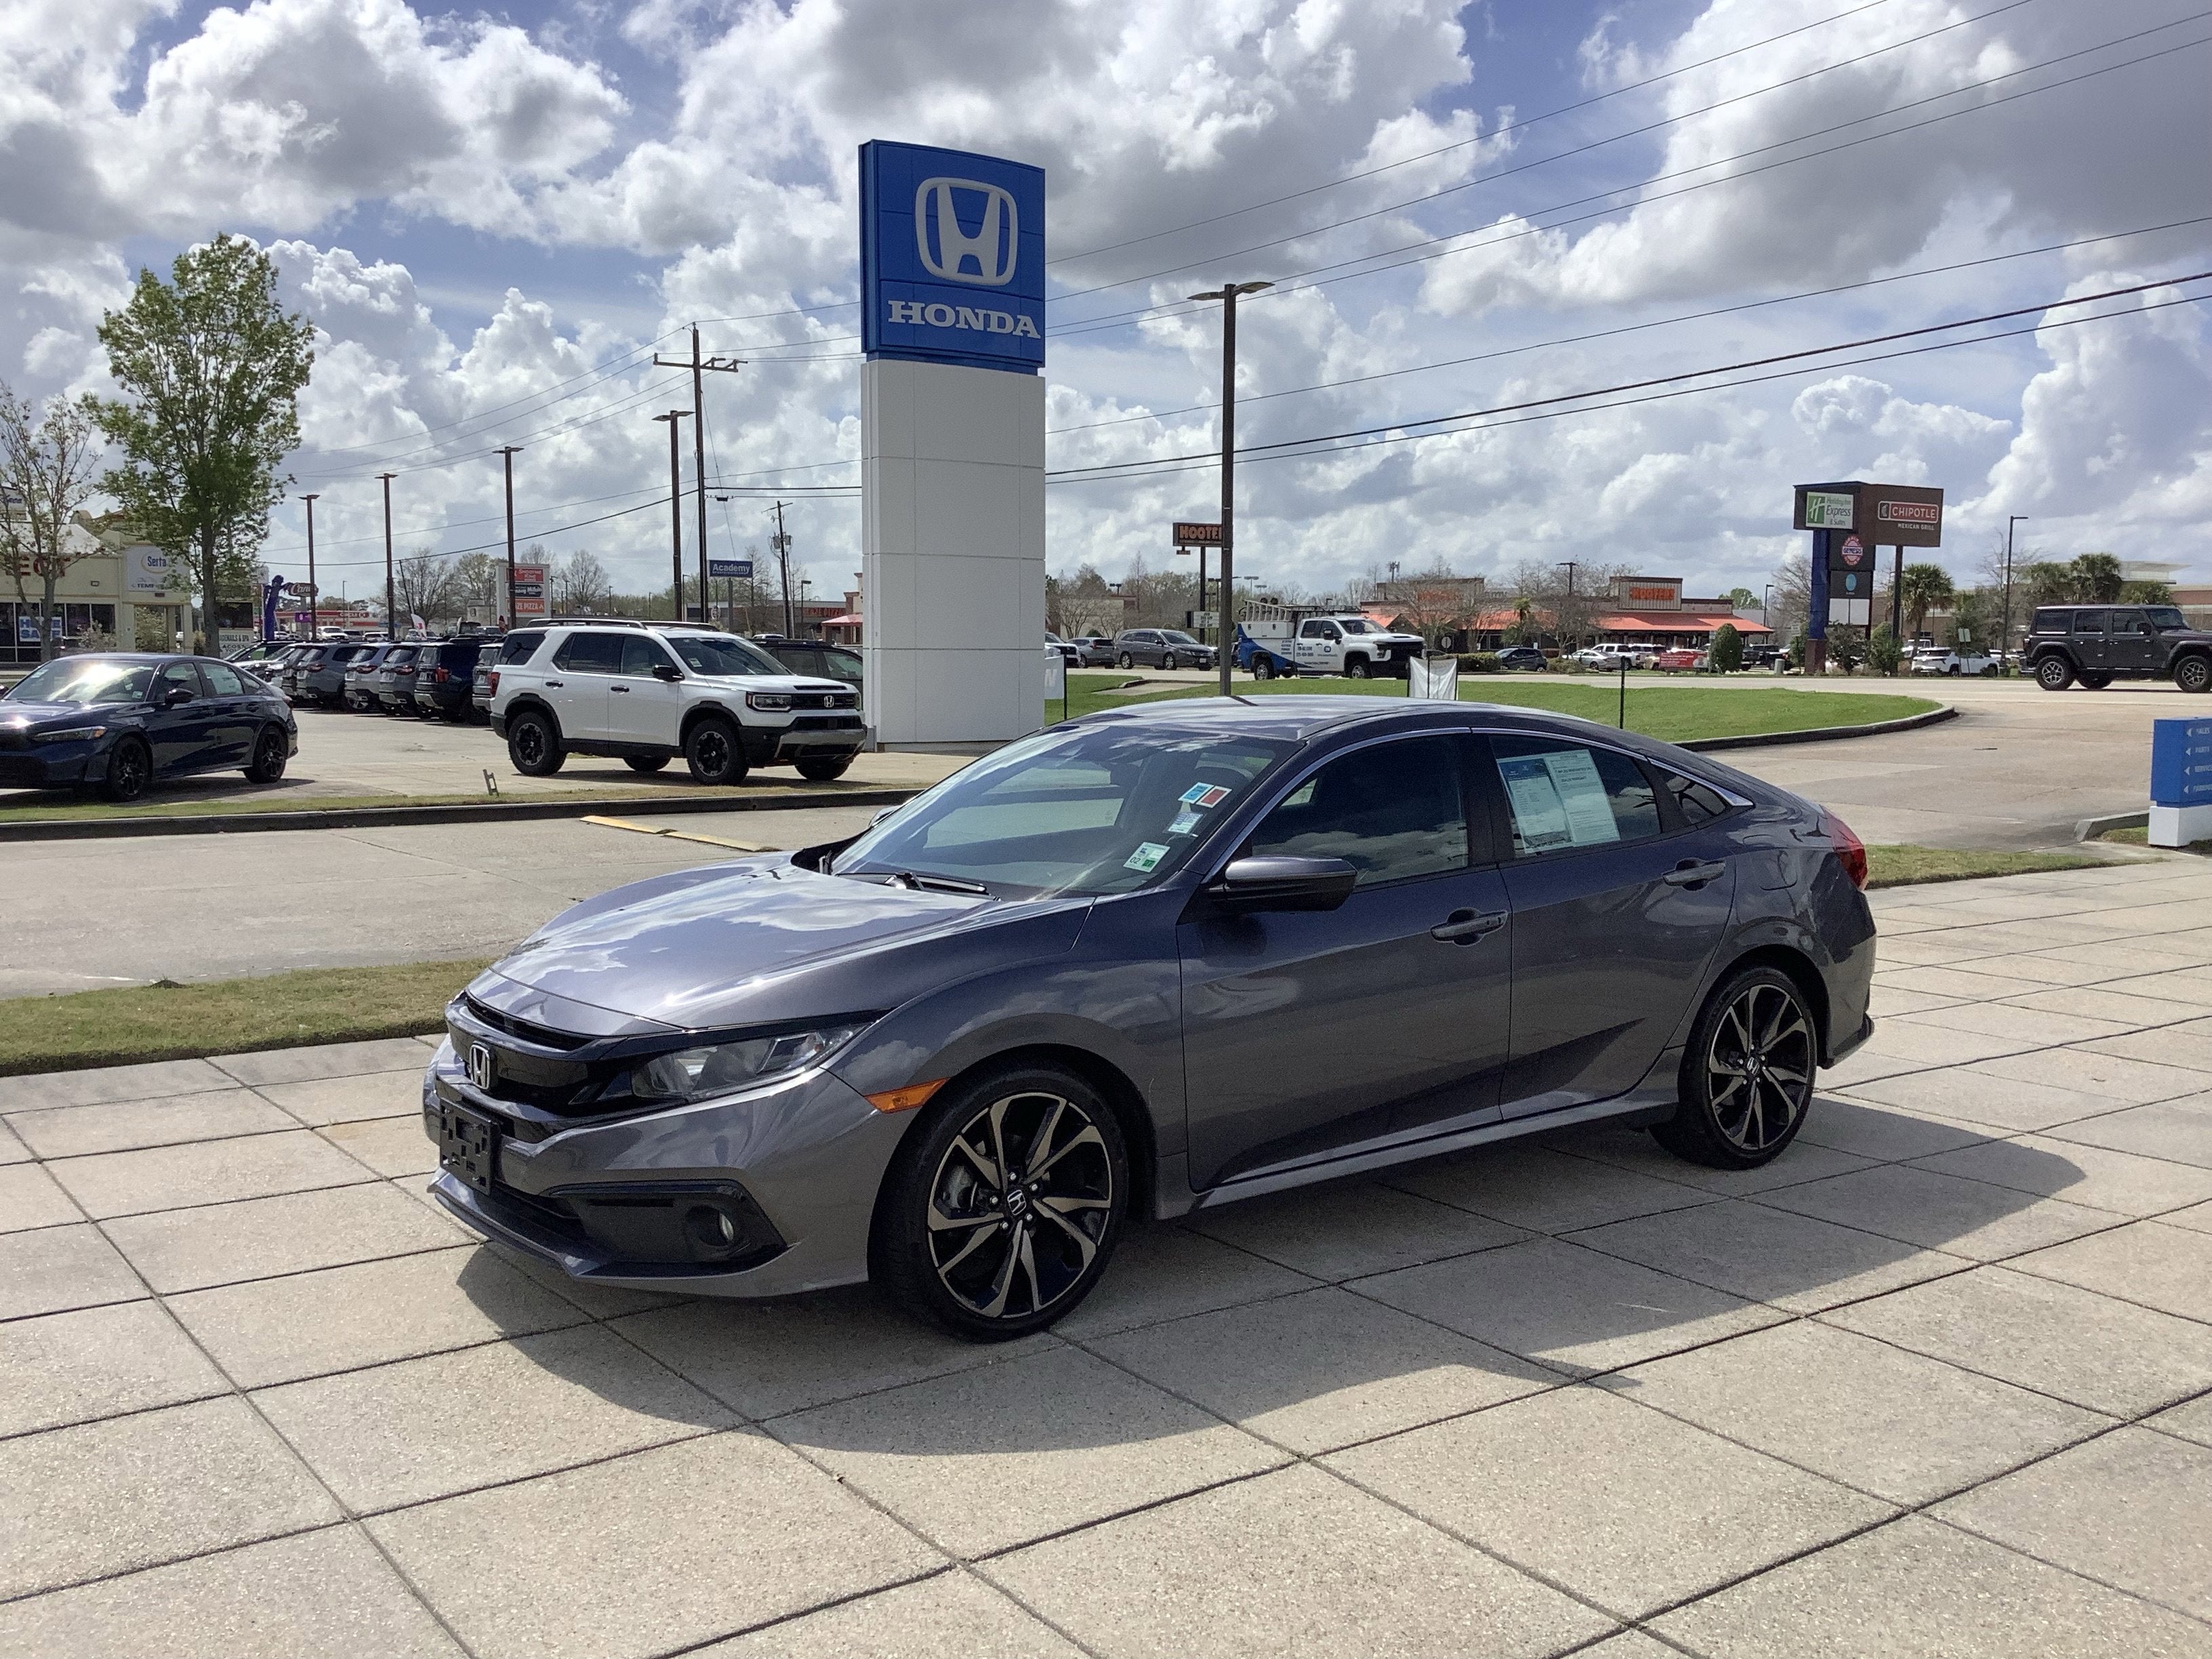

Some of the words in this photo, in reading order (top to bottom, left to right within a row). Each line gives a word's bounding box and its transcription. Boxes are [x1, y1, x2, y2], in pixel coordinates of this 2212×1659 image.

[888, 300, 1041, 339] HONDA
[1826, 504, 1851, 518] Express
[1891, 506, 1936, 519] CHIPOTLE
[147, 556, 167, 567] Serta
[712, 563, 750, 575] Academy
[1631, 588, 1675, 600] HOOTERS
